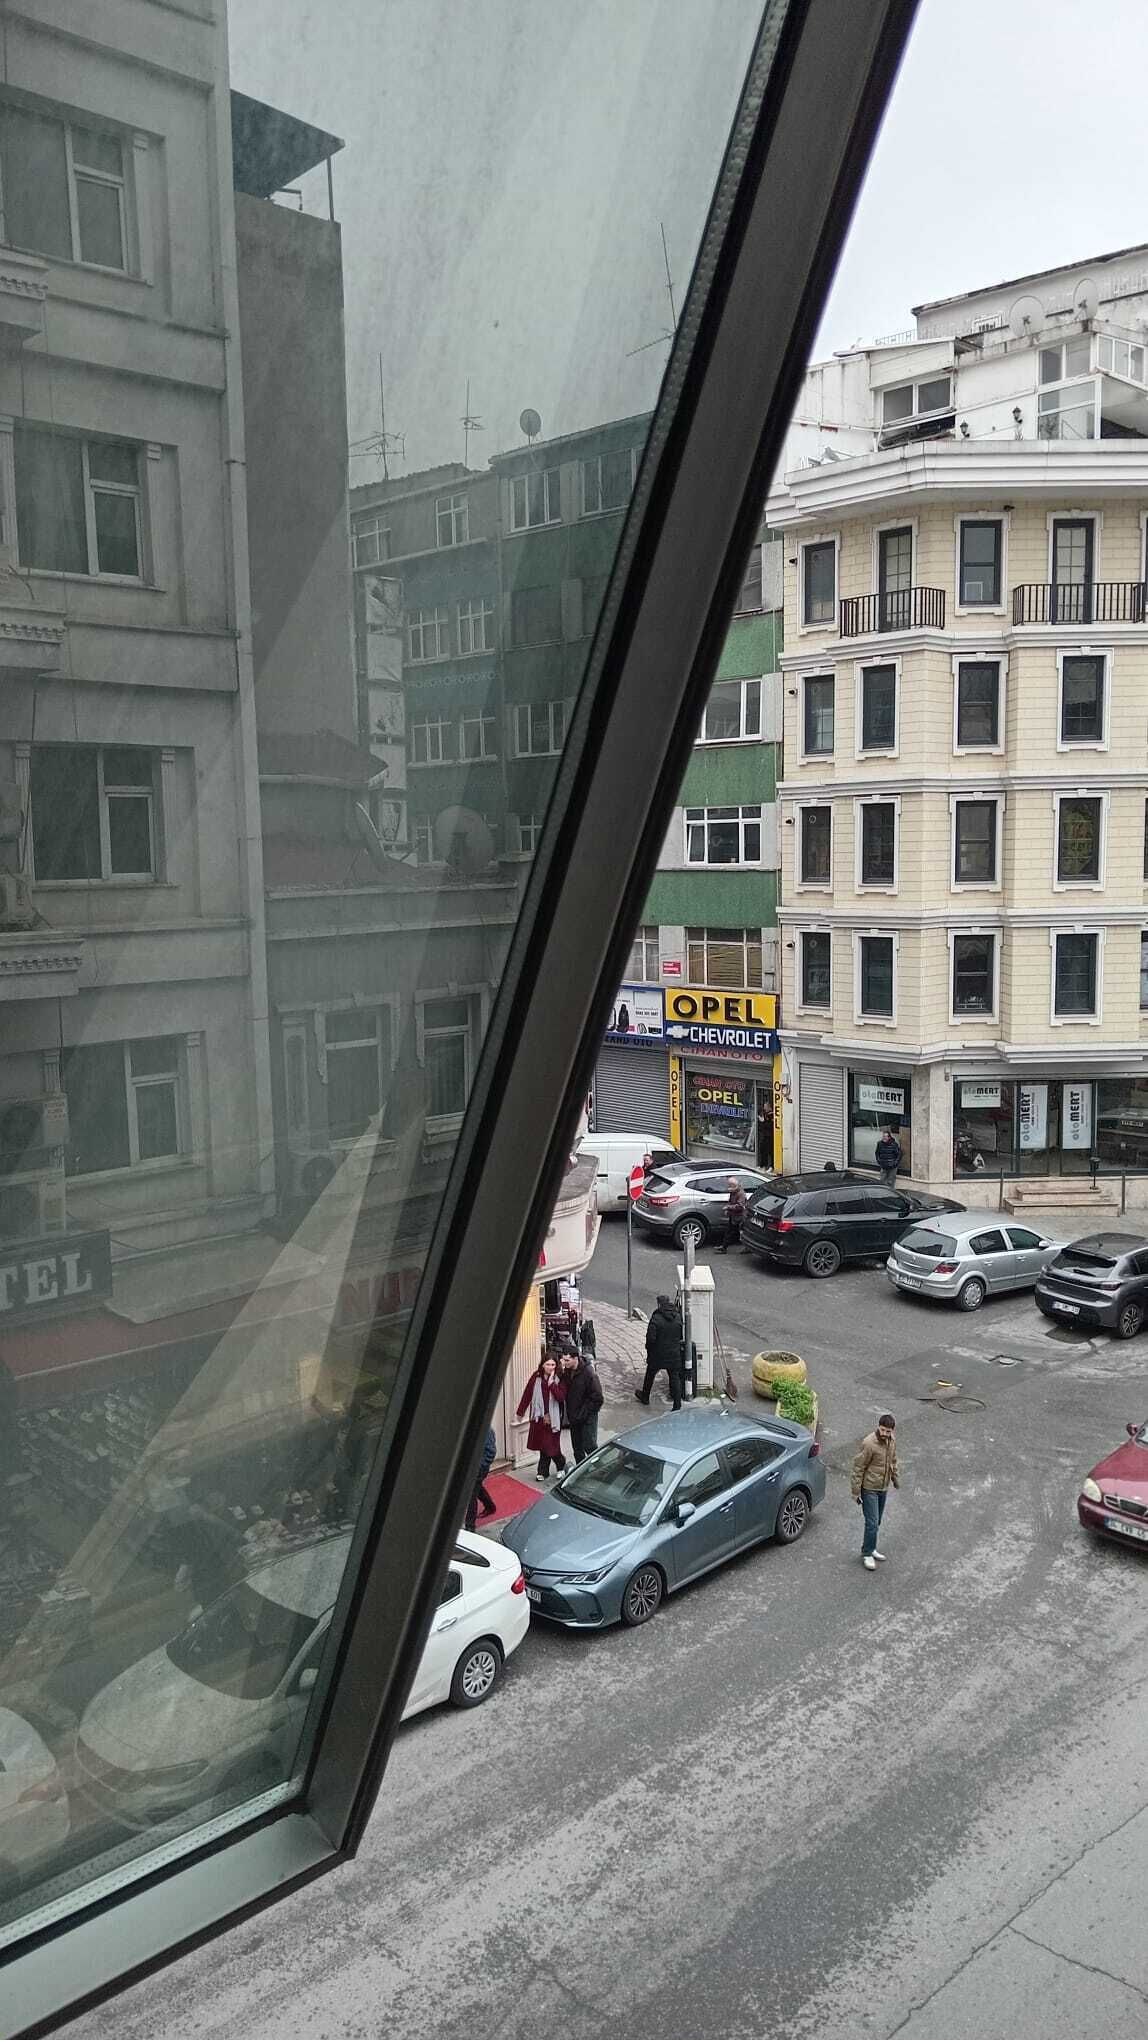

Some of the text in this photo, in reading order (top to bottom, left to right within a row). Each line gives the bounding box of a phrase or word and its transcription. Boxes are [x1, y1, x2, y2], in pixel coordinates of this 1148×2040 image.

[672, 995, 766, 1024] OPEL
[690, 1026, 772, 1049] CHEVROLET
[671, 1070, 679, 1121] OPEL
[698, 1088, 743, 1106] OPEL
